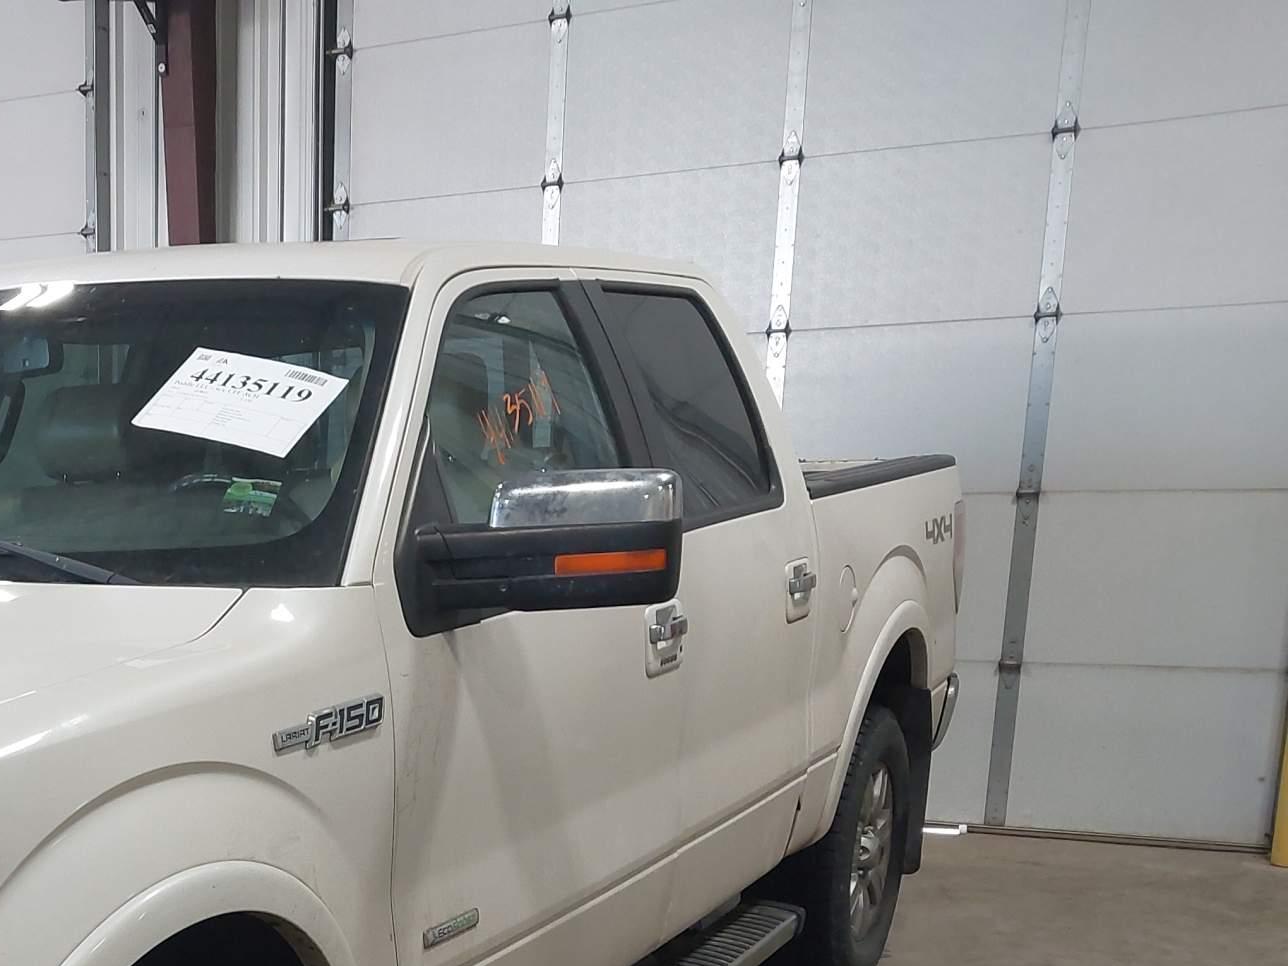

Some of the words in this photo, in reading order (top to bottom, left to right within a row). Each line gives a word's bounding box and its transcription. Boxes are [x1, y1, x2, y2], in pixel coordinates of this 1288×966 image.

[190, 367, 313, 402] 44135119
[280, 727, 310, 743] LARIAT
[314, 696, 384, 742] F-150
